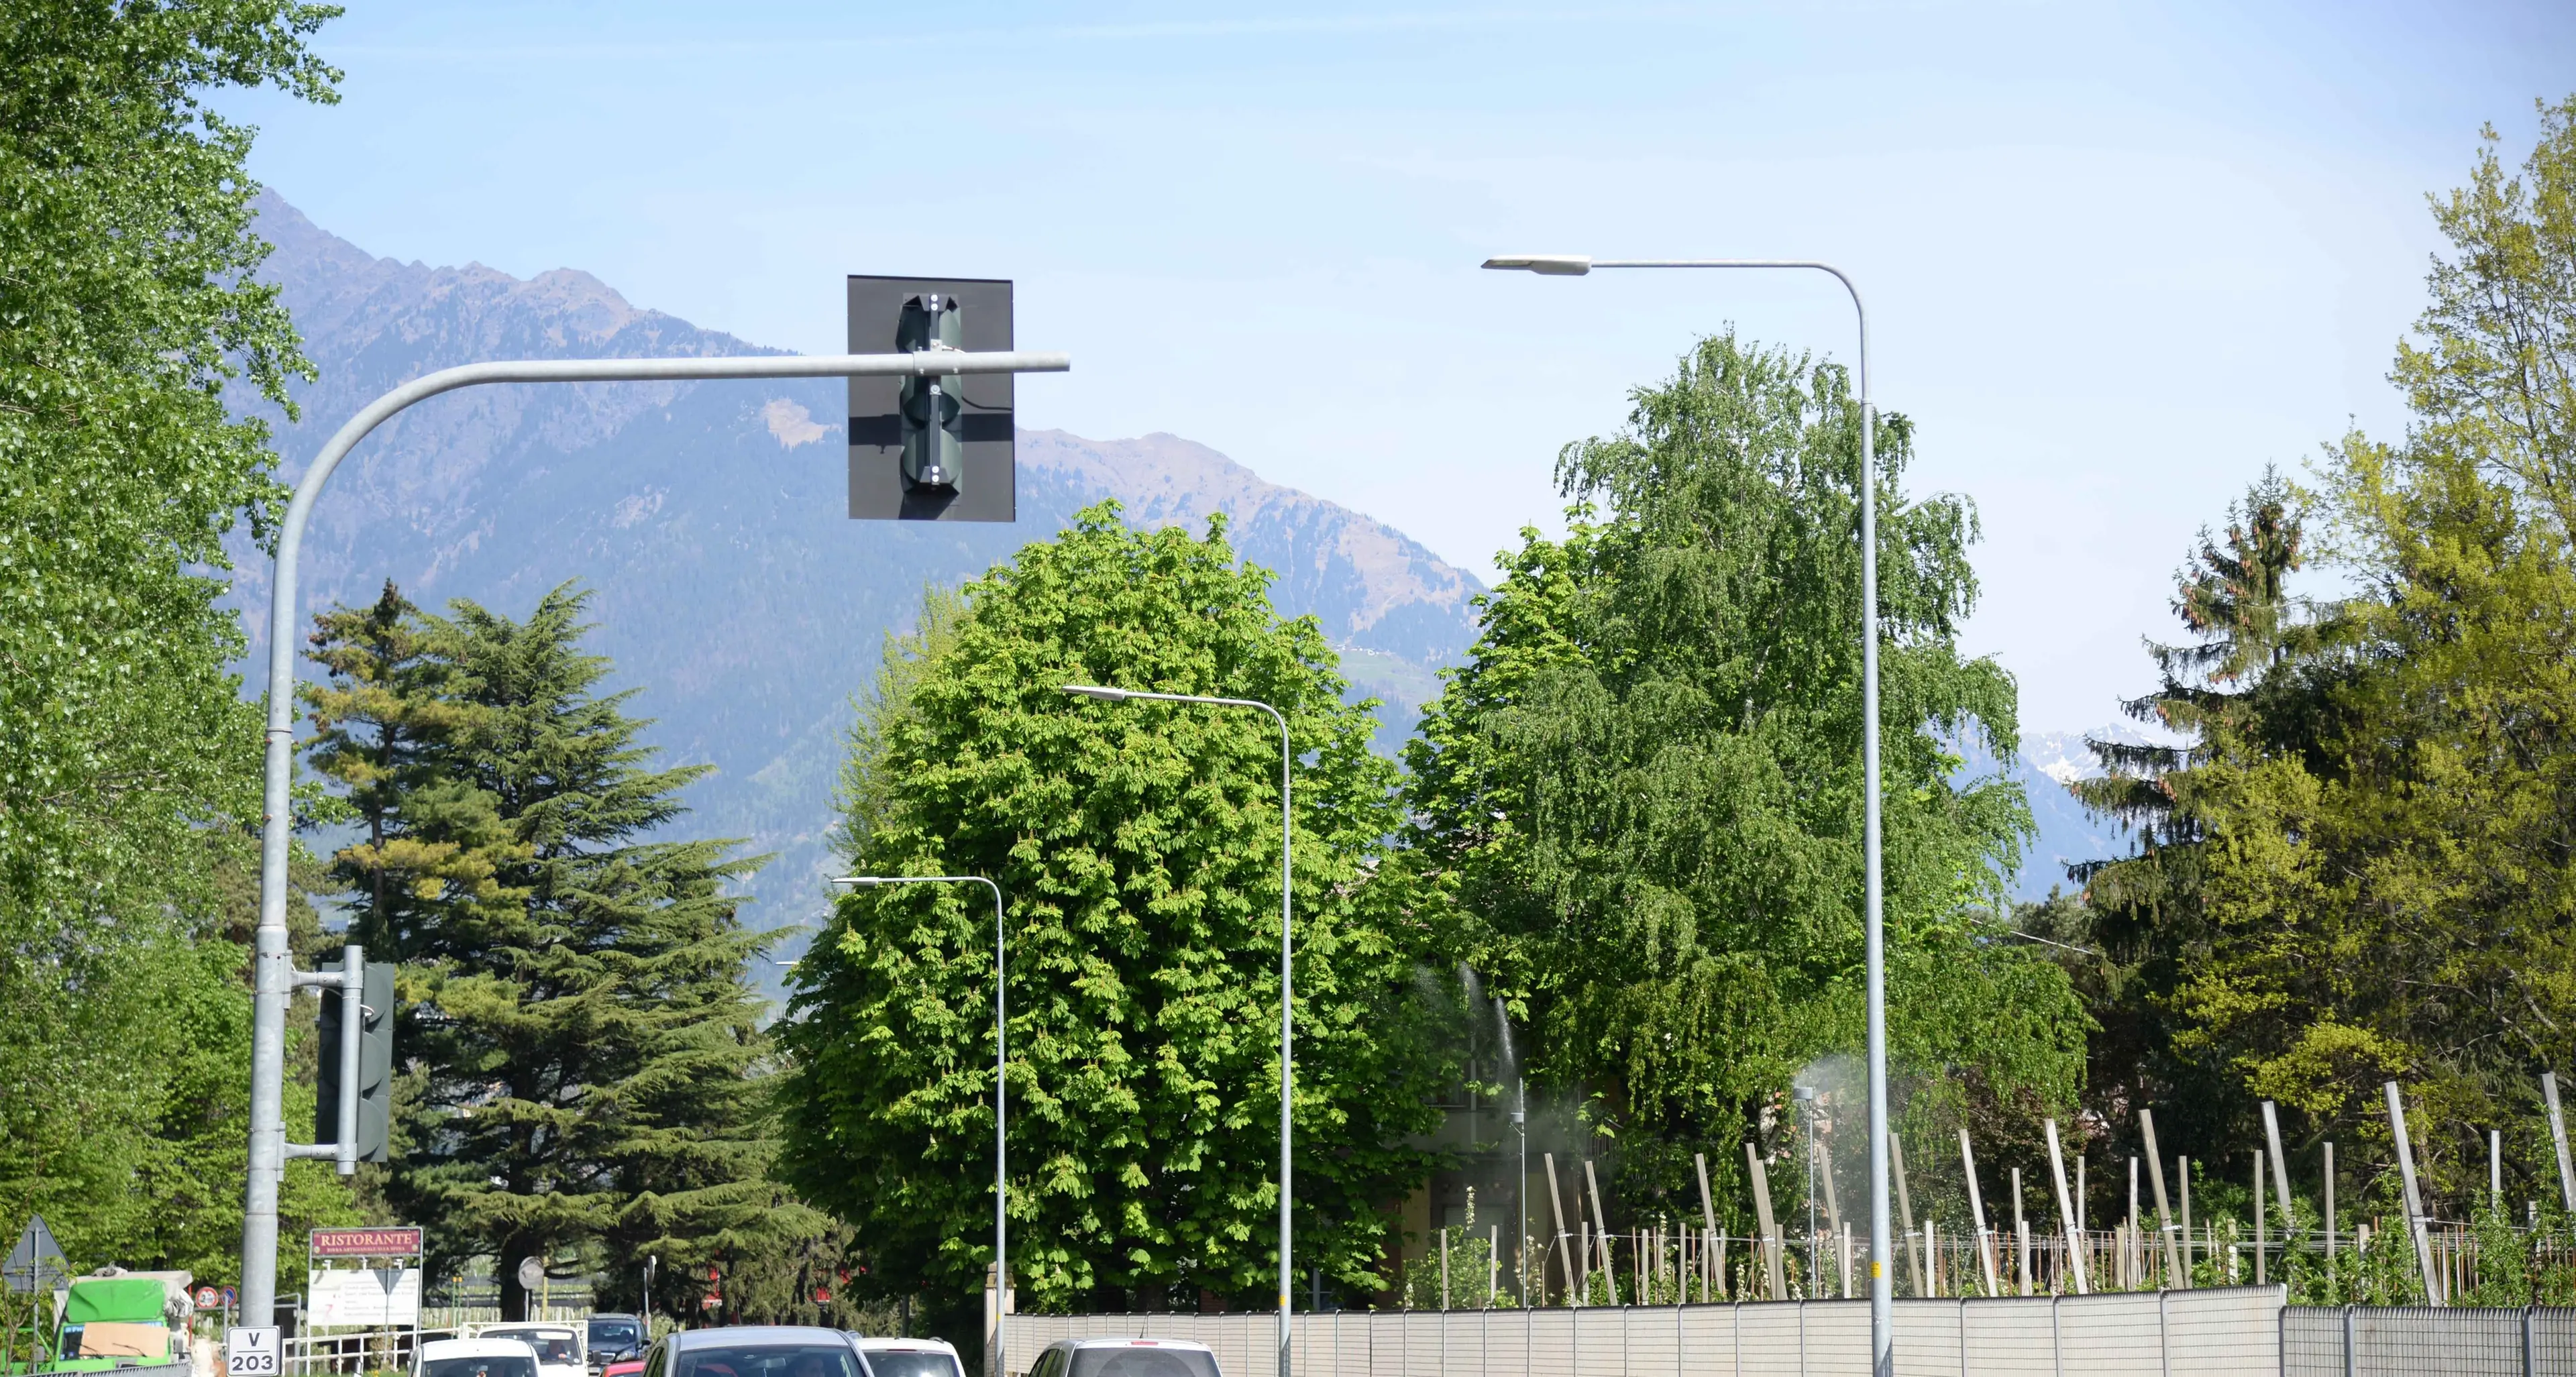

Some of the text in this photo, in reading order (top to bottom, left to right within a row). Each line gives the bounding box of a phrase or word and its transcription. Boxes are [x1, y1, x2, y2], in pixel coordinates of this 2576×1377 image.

[321, 1233, 413, 1246] RISTORANTE
[248, 1332, 260, 1347] V
[231, 1355, 273, 1371] 203
